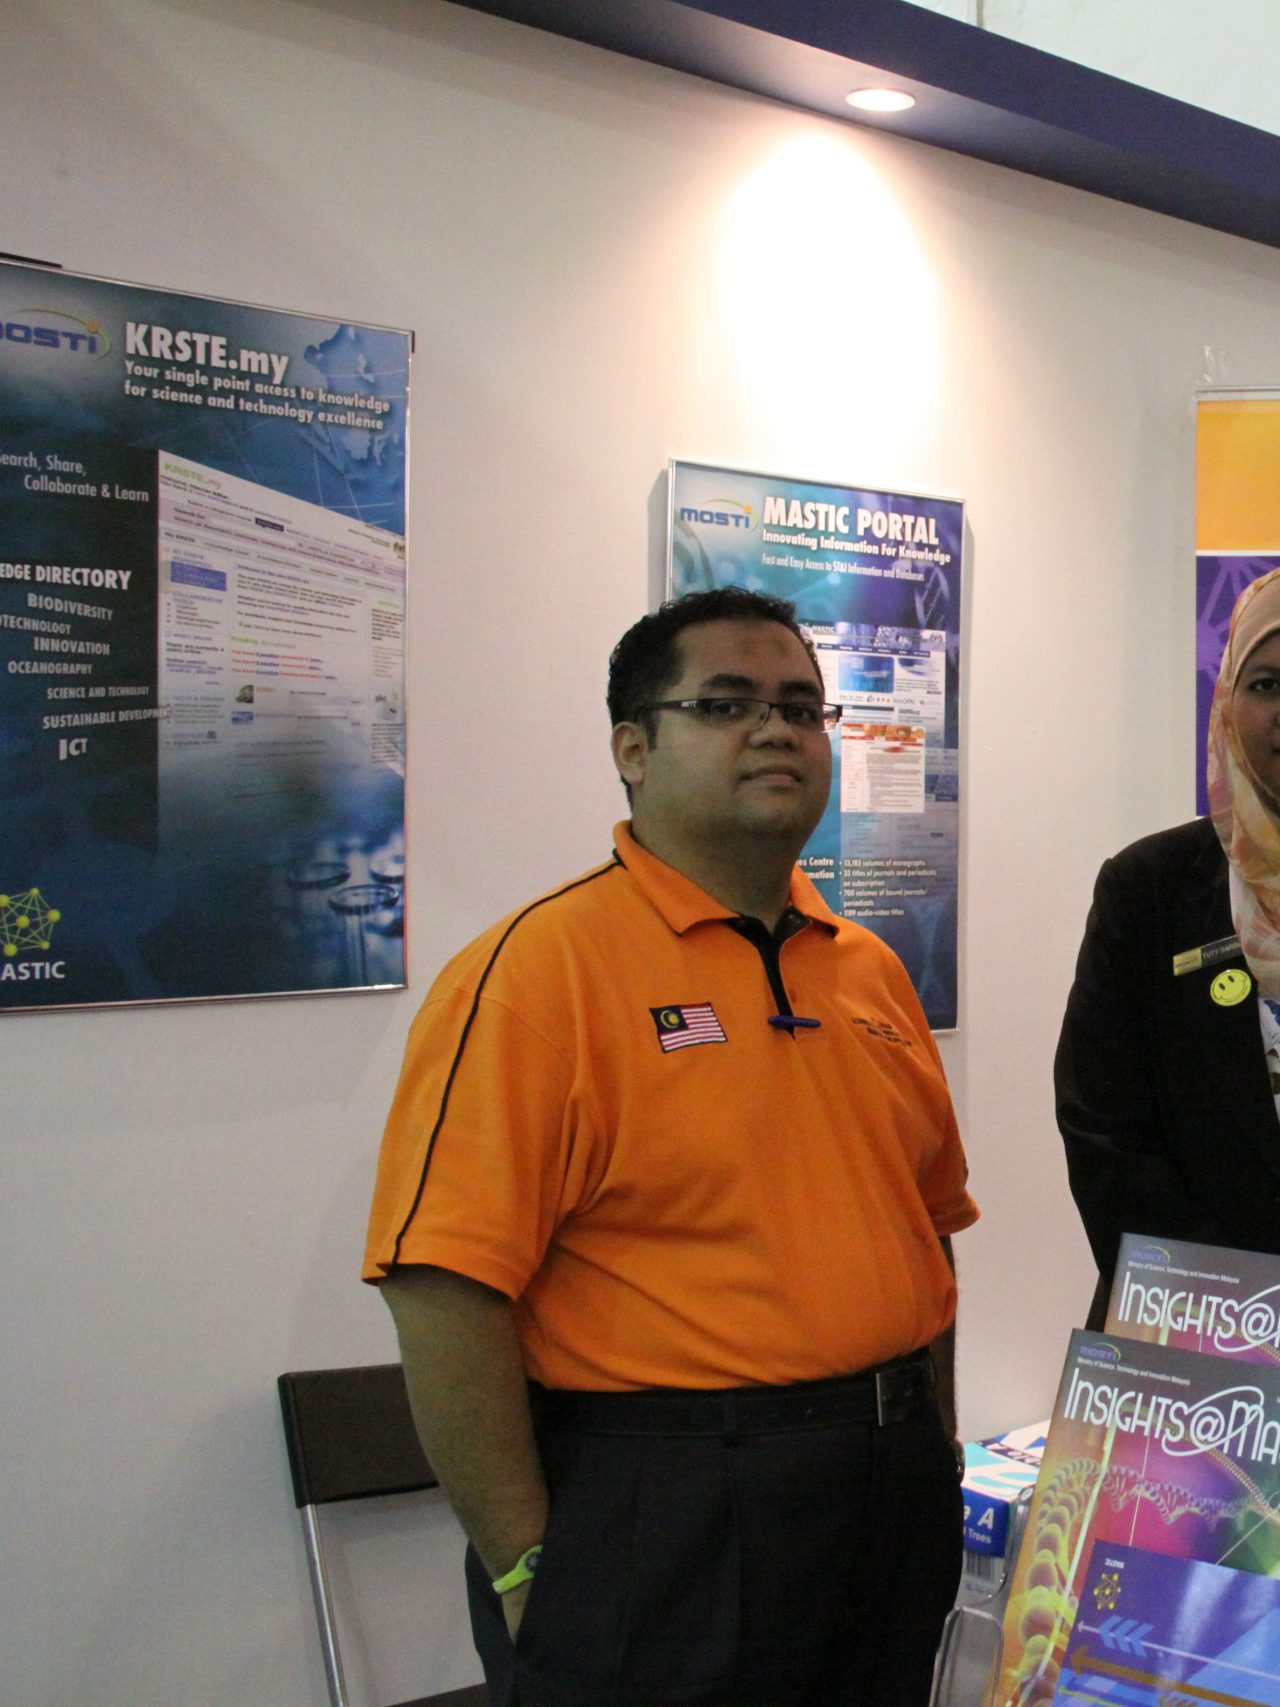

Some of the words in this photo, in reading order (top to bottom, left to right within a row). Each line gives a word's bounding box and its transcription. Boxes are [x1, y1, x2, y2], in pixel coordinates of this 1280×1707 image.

[0, 322, 97, 354] OSTI
[126, 322, 289, 384] KRSTE.my
[124, 360, 159, 378] Your
[164, 366, 208, 387] single
[213, 374, 251, 391] point
[255, 382, 297, 398] access
[301, 386, 314, 400] to
[318, 389, 390, 413] knowledge
[124, 380, 147, 397] for
[152, 386, 203, 404] science
[207, 393, 234, 409] and
[239, 399, 314, 423] technology
[318, 411, 384, 430] excellence
[46, 455, 87, 476] Share,
[24, 474, 97, 496] Collaborate
[101, 484, 111, 498] &
[115, 485, 149, 501] Learn
[763, 496, 850, 534] MASTIC
[857, 510, 939, 545] PORTAL
[762, 529, 818, 551] Innovating
[820, 535, 879, 554] Information
[898, 546, 951, 565] Knowledge
[36, 565, 132, 590] DIRECTORY
[762, 554, 775, 565] Fast
[776, 555, 788, 566] and
[790, 556, 804, 570] Easy
[805, 559, 824, 571] Access
[848, 563, 882, 577] Information
[27, 593, 113, 621] BIODIVERSITY
[34, 636, 110, 655] INNOVATION
[8, 661, 93, 674] OCEANOGRAPHY
[47, 687, 86, 699] SCIENCE
[89, 687, 105, 698] AND
[108, 686, 149, 696] TECHNOLOGY
[43, 711, 116, 729] SUSTAINABLE
[59, 738, 88, 760] ICT
[809, 857, 834, 866] Centre
[977, 1507, 995, 1530] A
